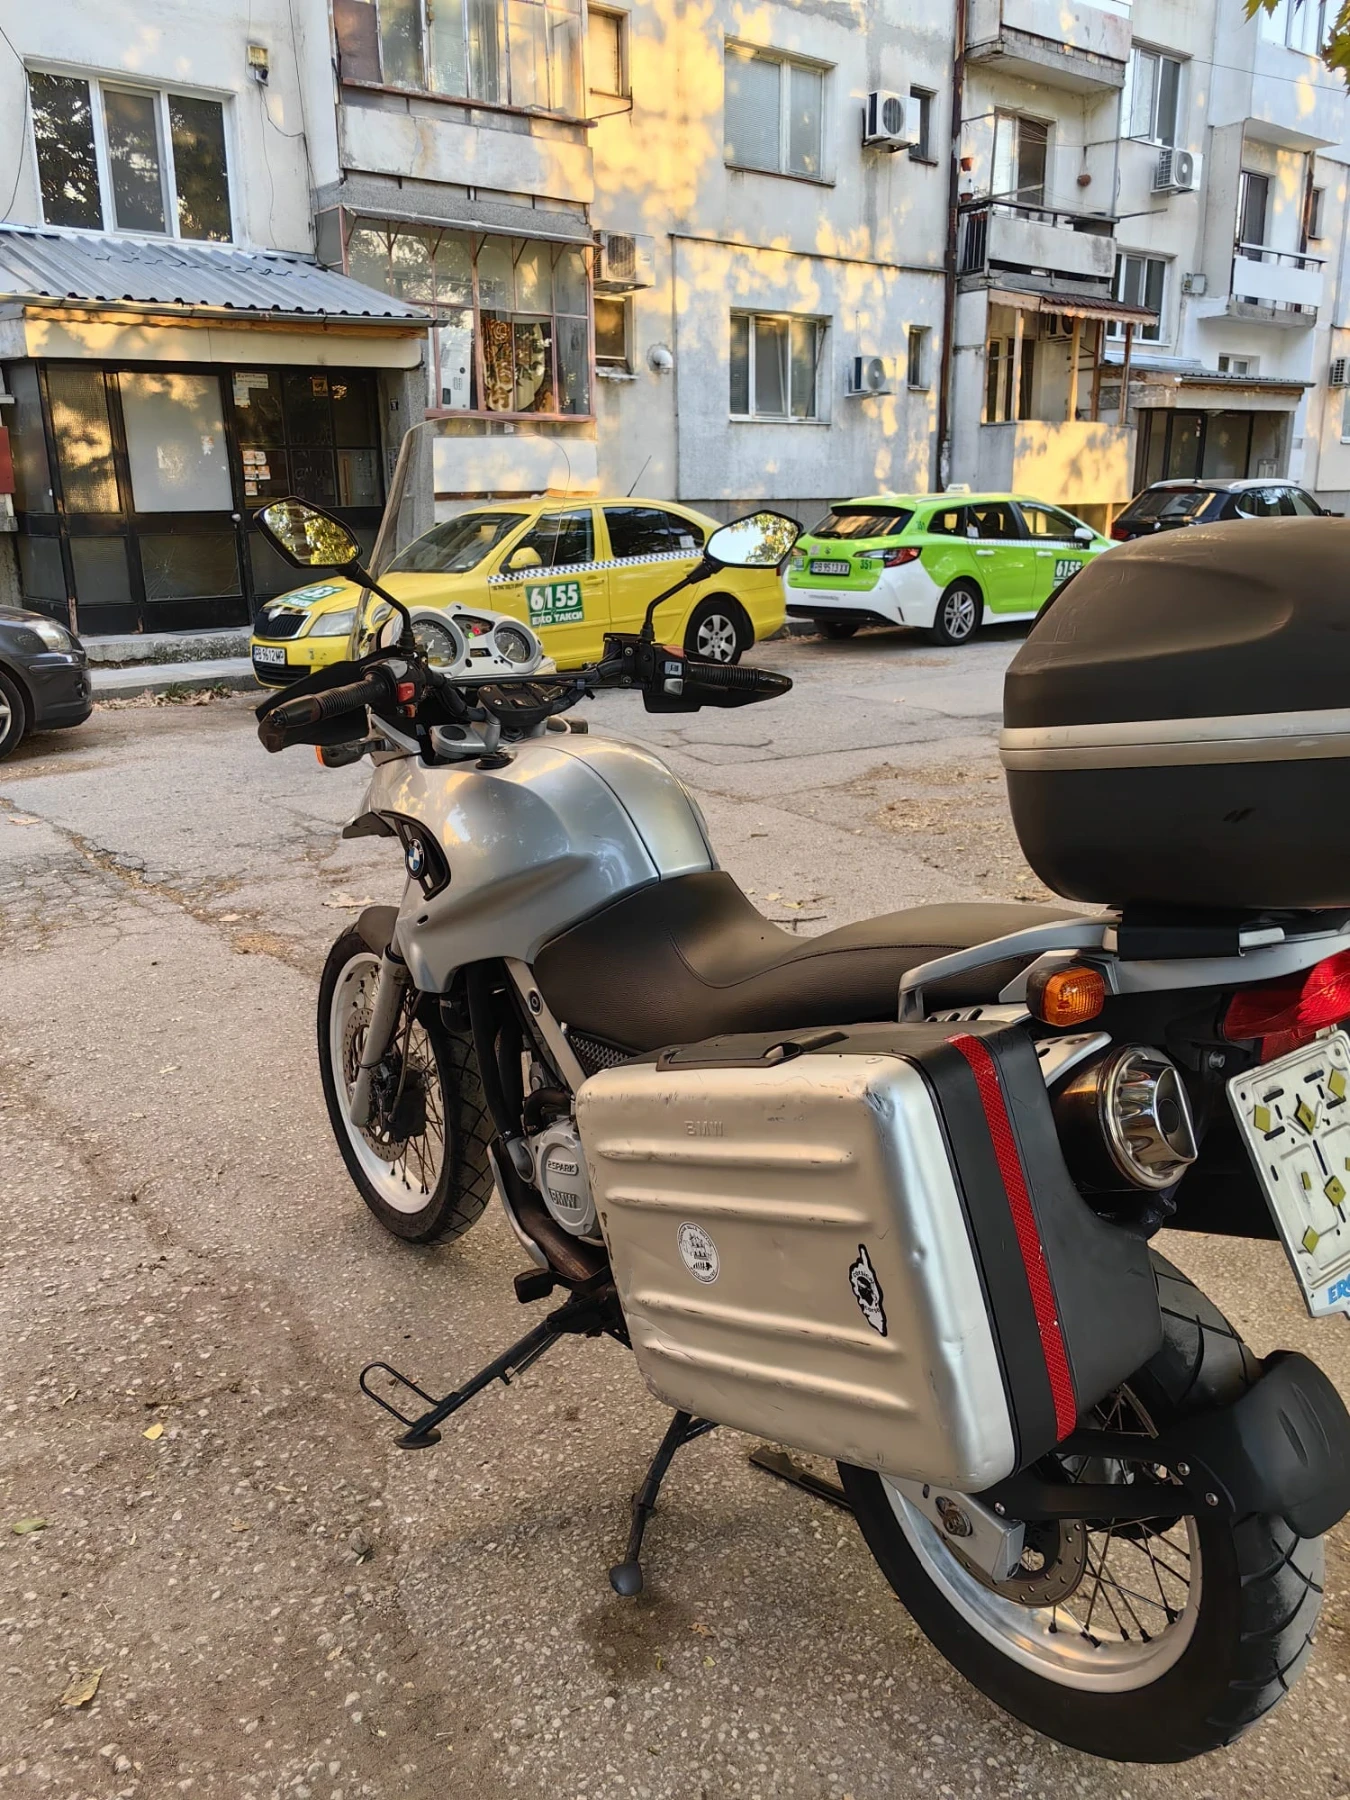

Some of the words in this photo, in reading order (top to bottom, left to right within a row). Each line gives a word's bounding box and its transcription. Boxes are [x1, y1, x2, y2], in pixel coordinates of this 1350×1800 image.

[859, 559, 873, 570] 351
[530, 584, 579, 611] 6155
[553, 611, 583, 622] ТАКСИ
[684, 1120, 724, 1137] BMW
[549, 1189, 578, 1208] BMW
